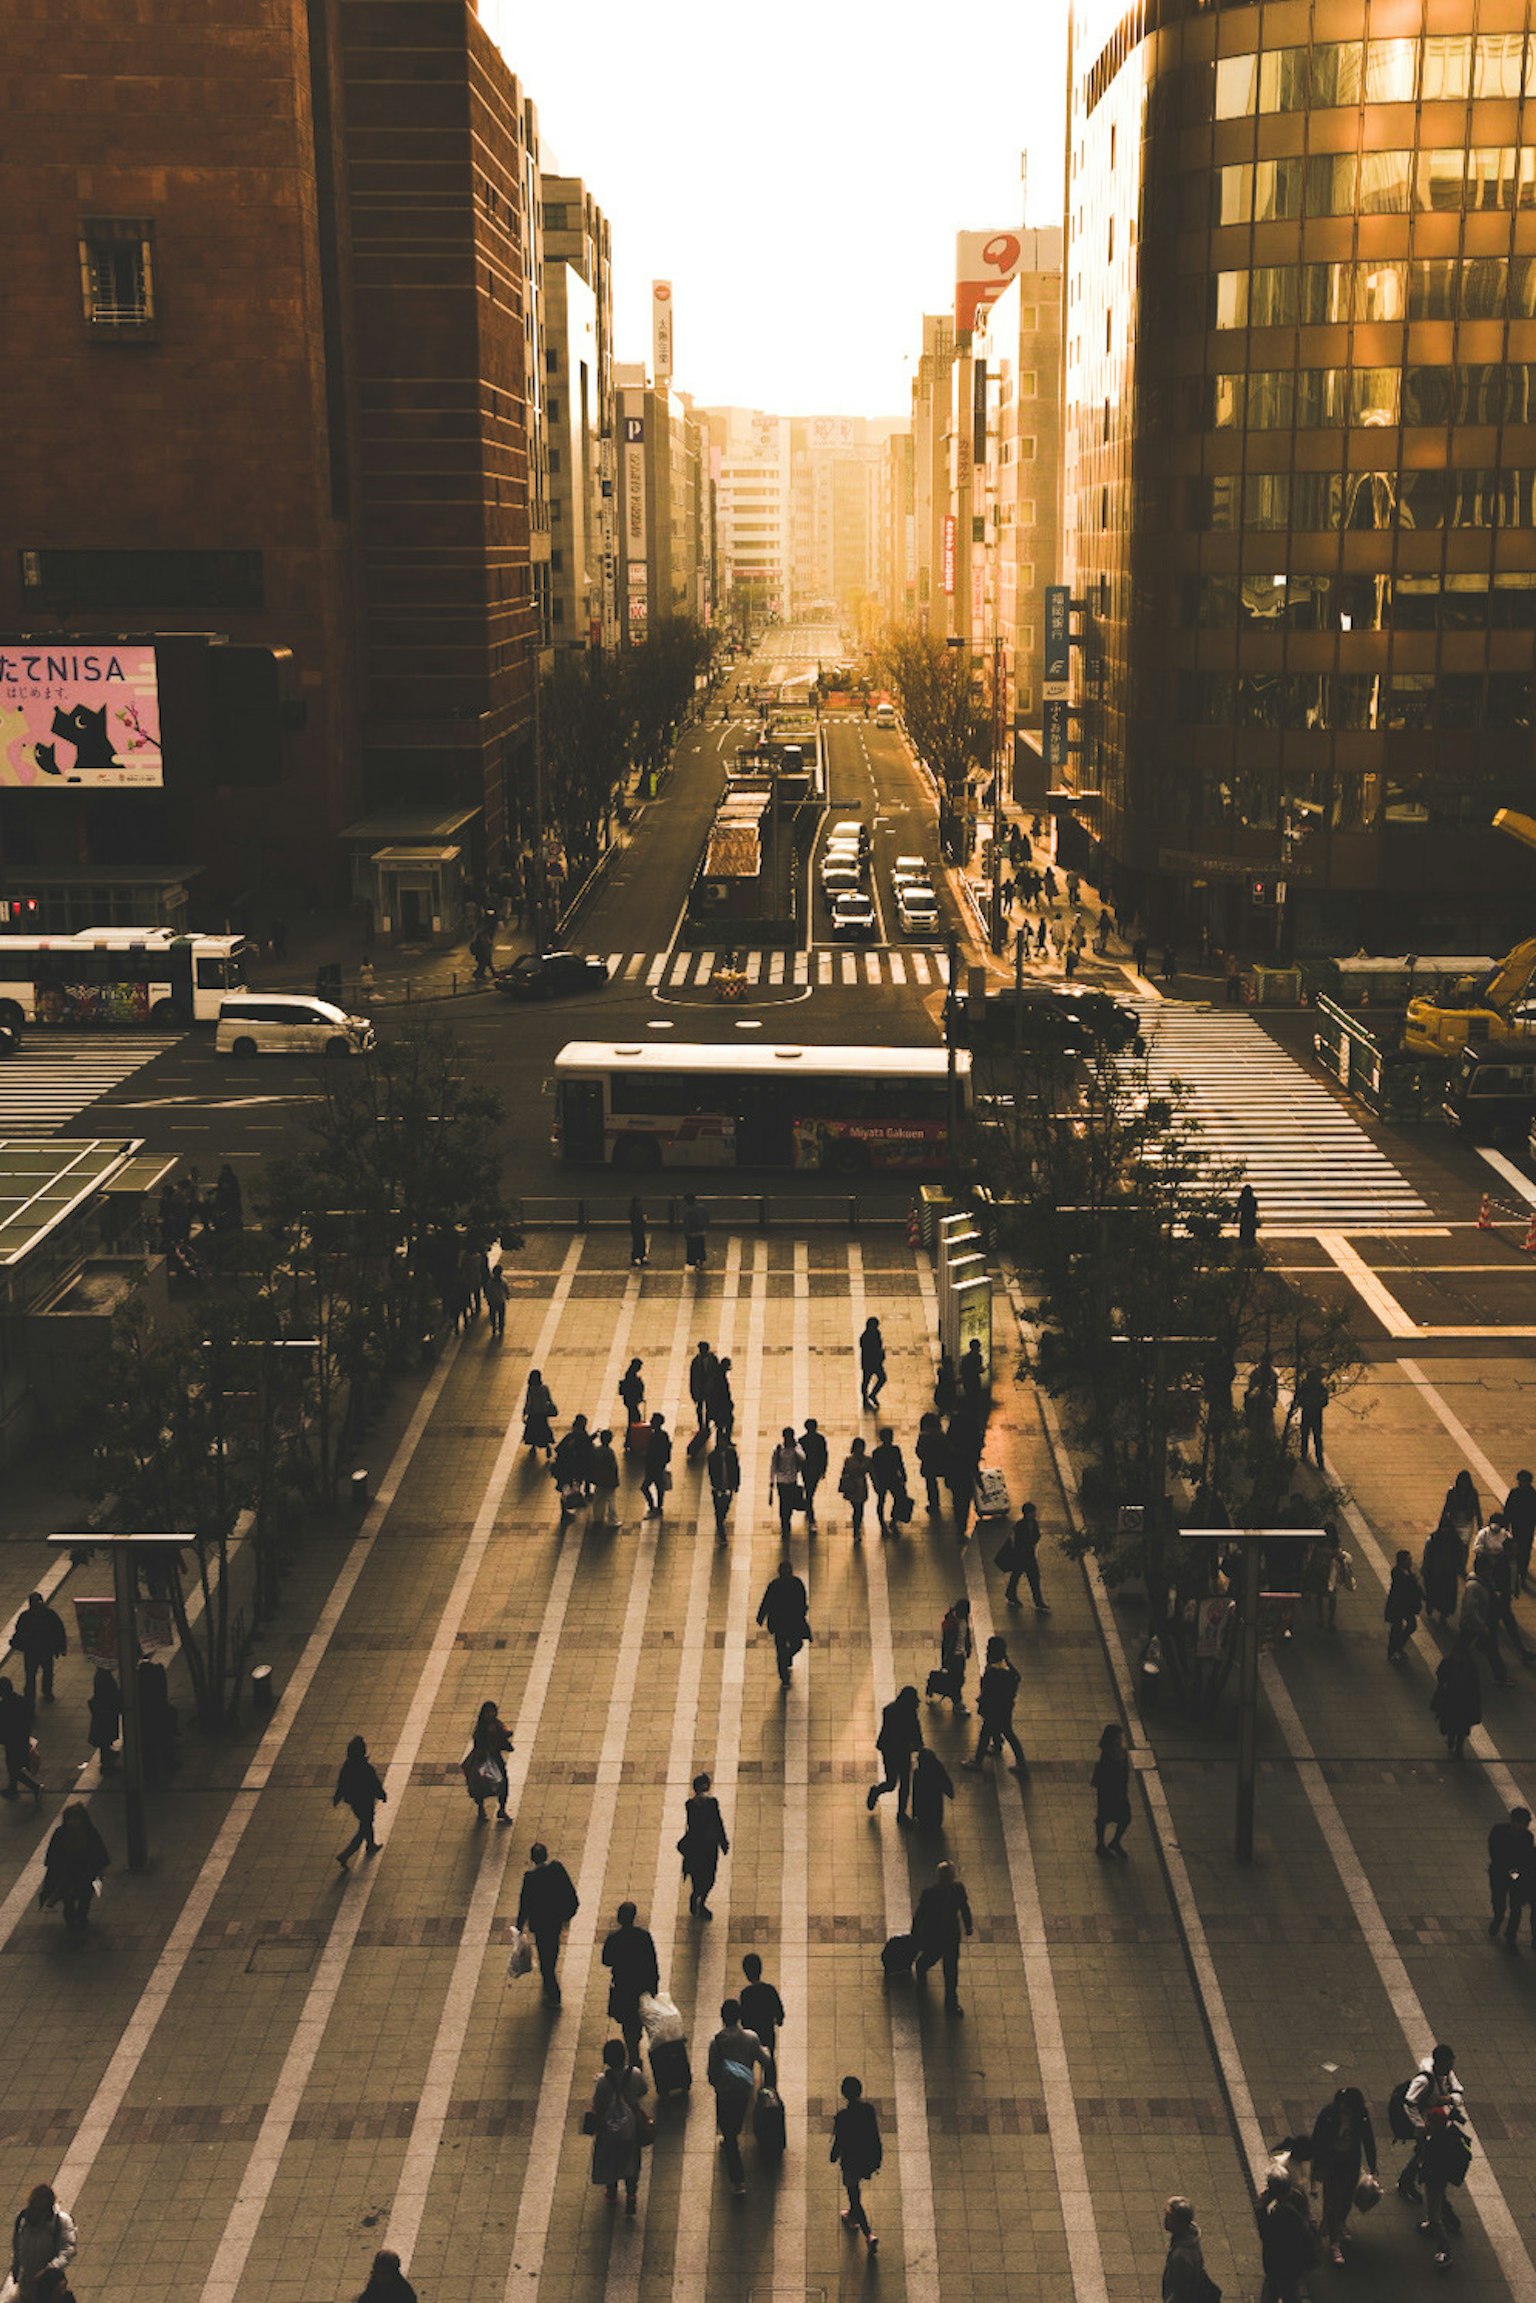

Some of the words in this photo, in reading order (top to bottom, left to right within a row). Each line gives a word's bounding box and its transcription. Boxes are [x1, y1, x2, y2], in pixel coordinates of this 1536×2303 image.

[629, 420, 641, 440] P
[1052, 592, 1064, 640] 福岡銀行
[850, 1127, 883, 1141] Miyata
[886, 1127, 925, 1139] Gakuen
